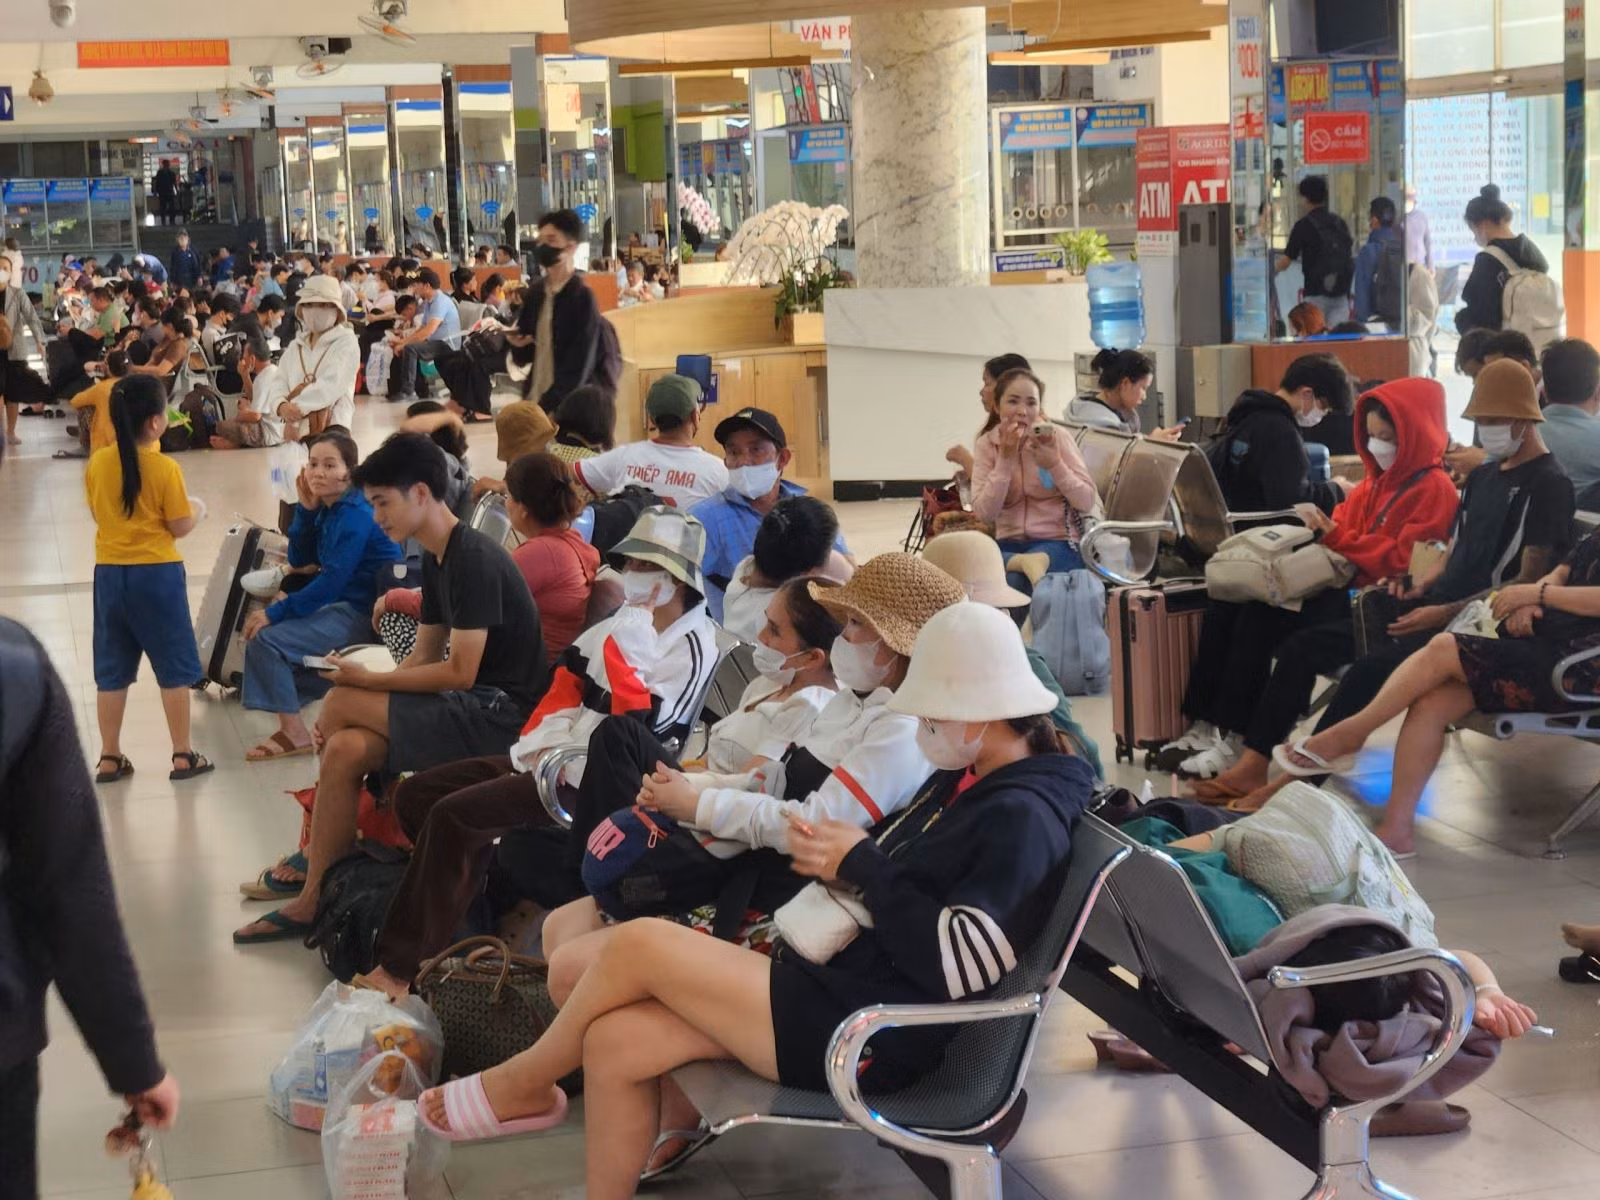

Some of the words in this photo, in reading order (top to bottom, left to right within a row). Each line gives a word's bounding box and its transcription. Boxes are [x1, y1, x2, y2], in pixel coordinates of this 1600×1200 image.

[1139, 181, 1170, 218] ATM
[1182, 179, 1231, 205] AT
[665, 469, 696, 489] AMA
